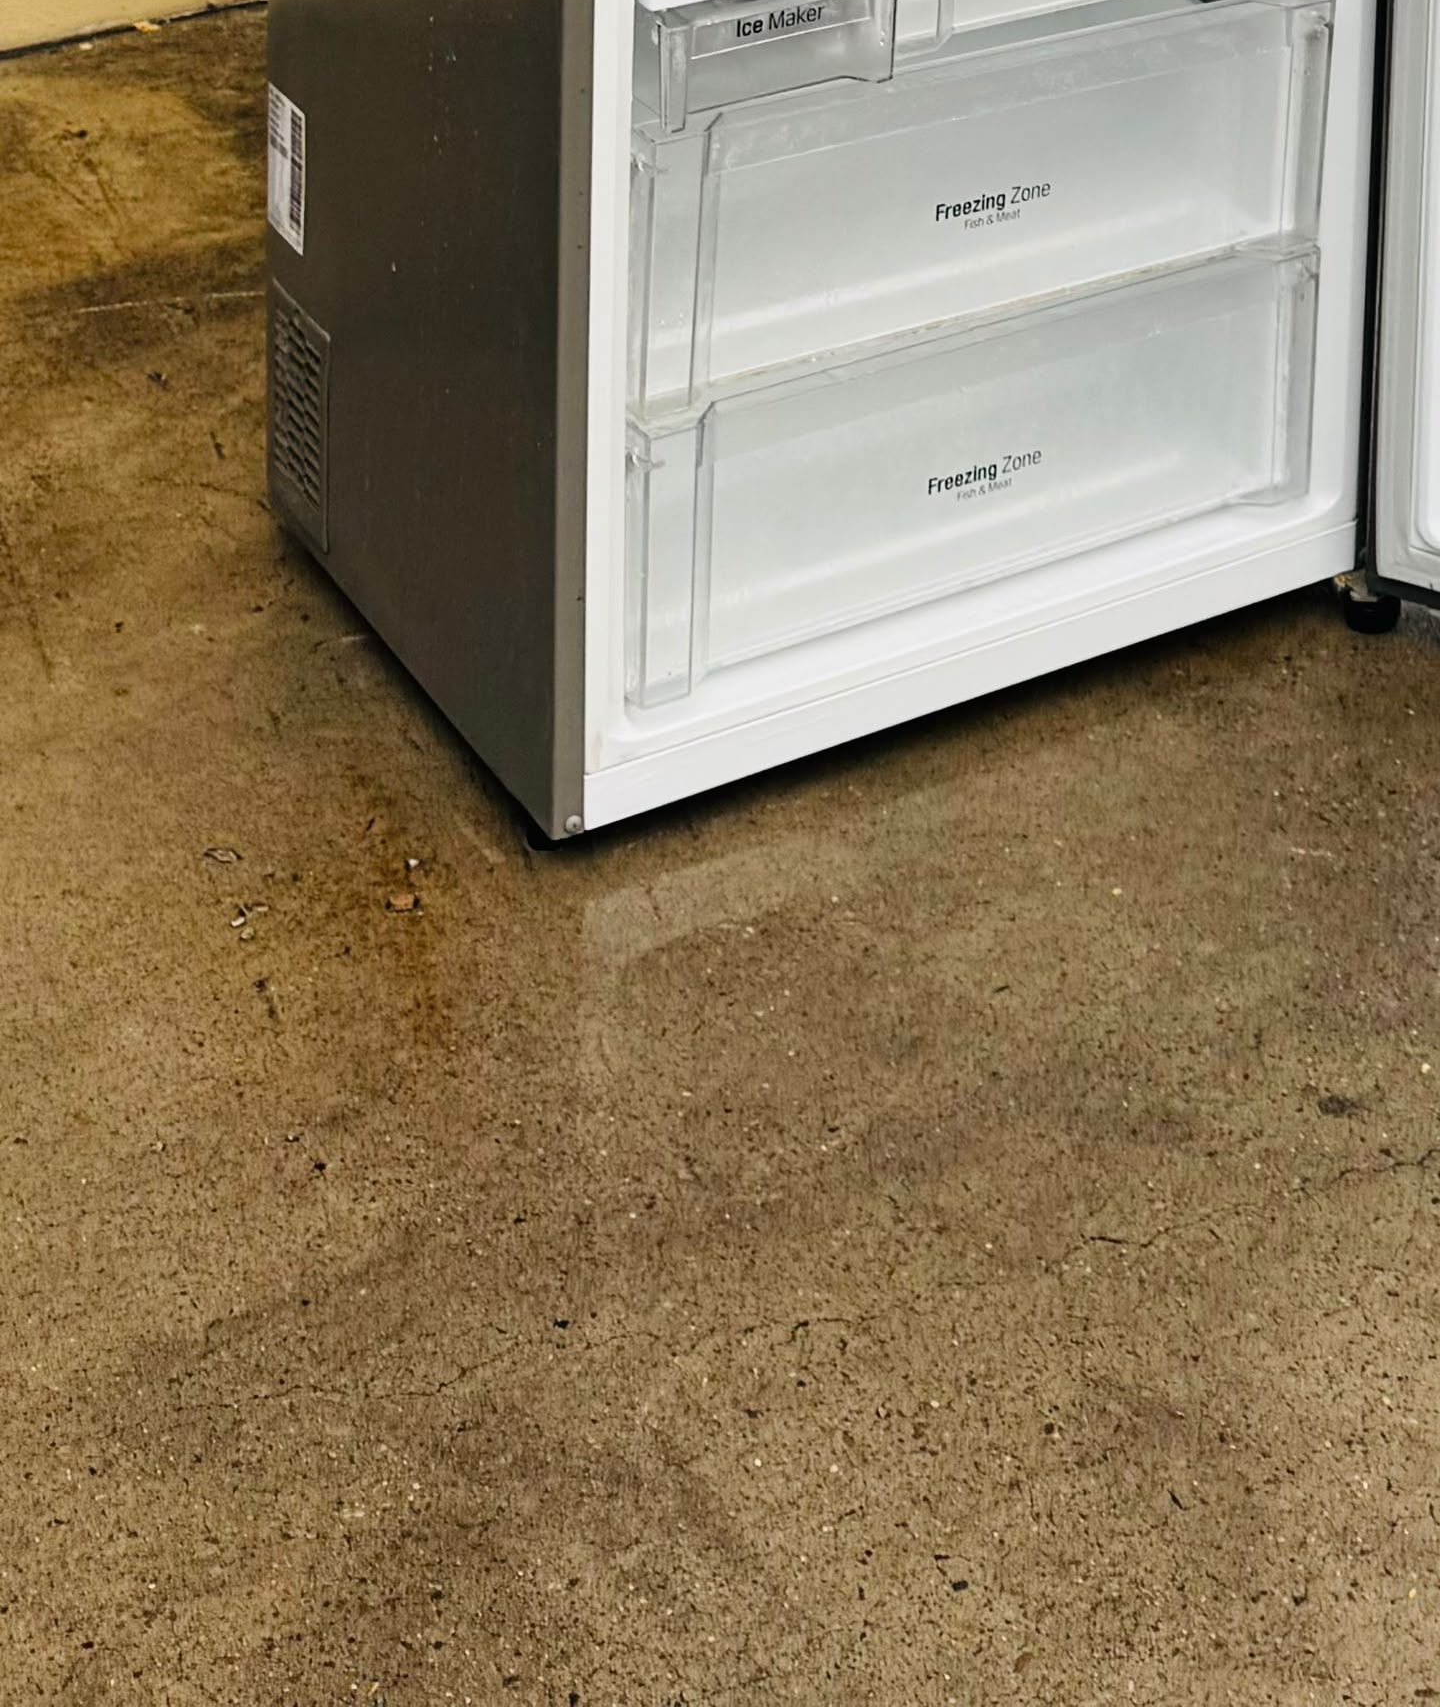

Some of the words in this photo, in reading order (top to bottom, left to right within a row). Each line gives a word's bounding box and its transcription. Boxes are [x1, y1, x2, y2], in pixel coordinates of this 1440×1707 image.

[736, 18, 763, 38] Ice
[768, 4, 825, 31] Maker
[935, 193, 1006, 222] Freezing
[1010, 182, 1051, 204] Zone
[964, 216, 984, 230] Fish
[986, 214, 994, 225] &
[996, 208, 1021, 223] Meat
[928, 463, 997, 495] Freezing
[1002, 449, 1042, 474] Zone
[956, 489, 977, 502] Fish
[978, 485, 986, 496] &
[988, 478, 1012, 493] Meat
